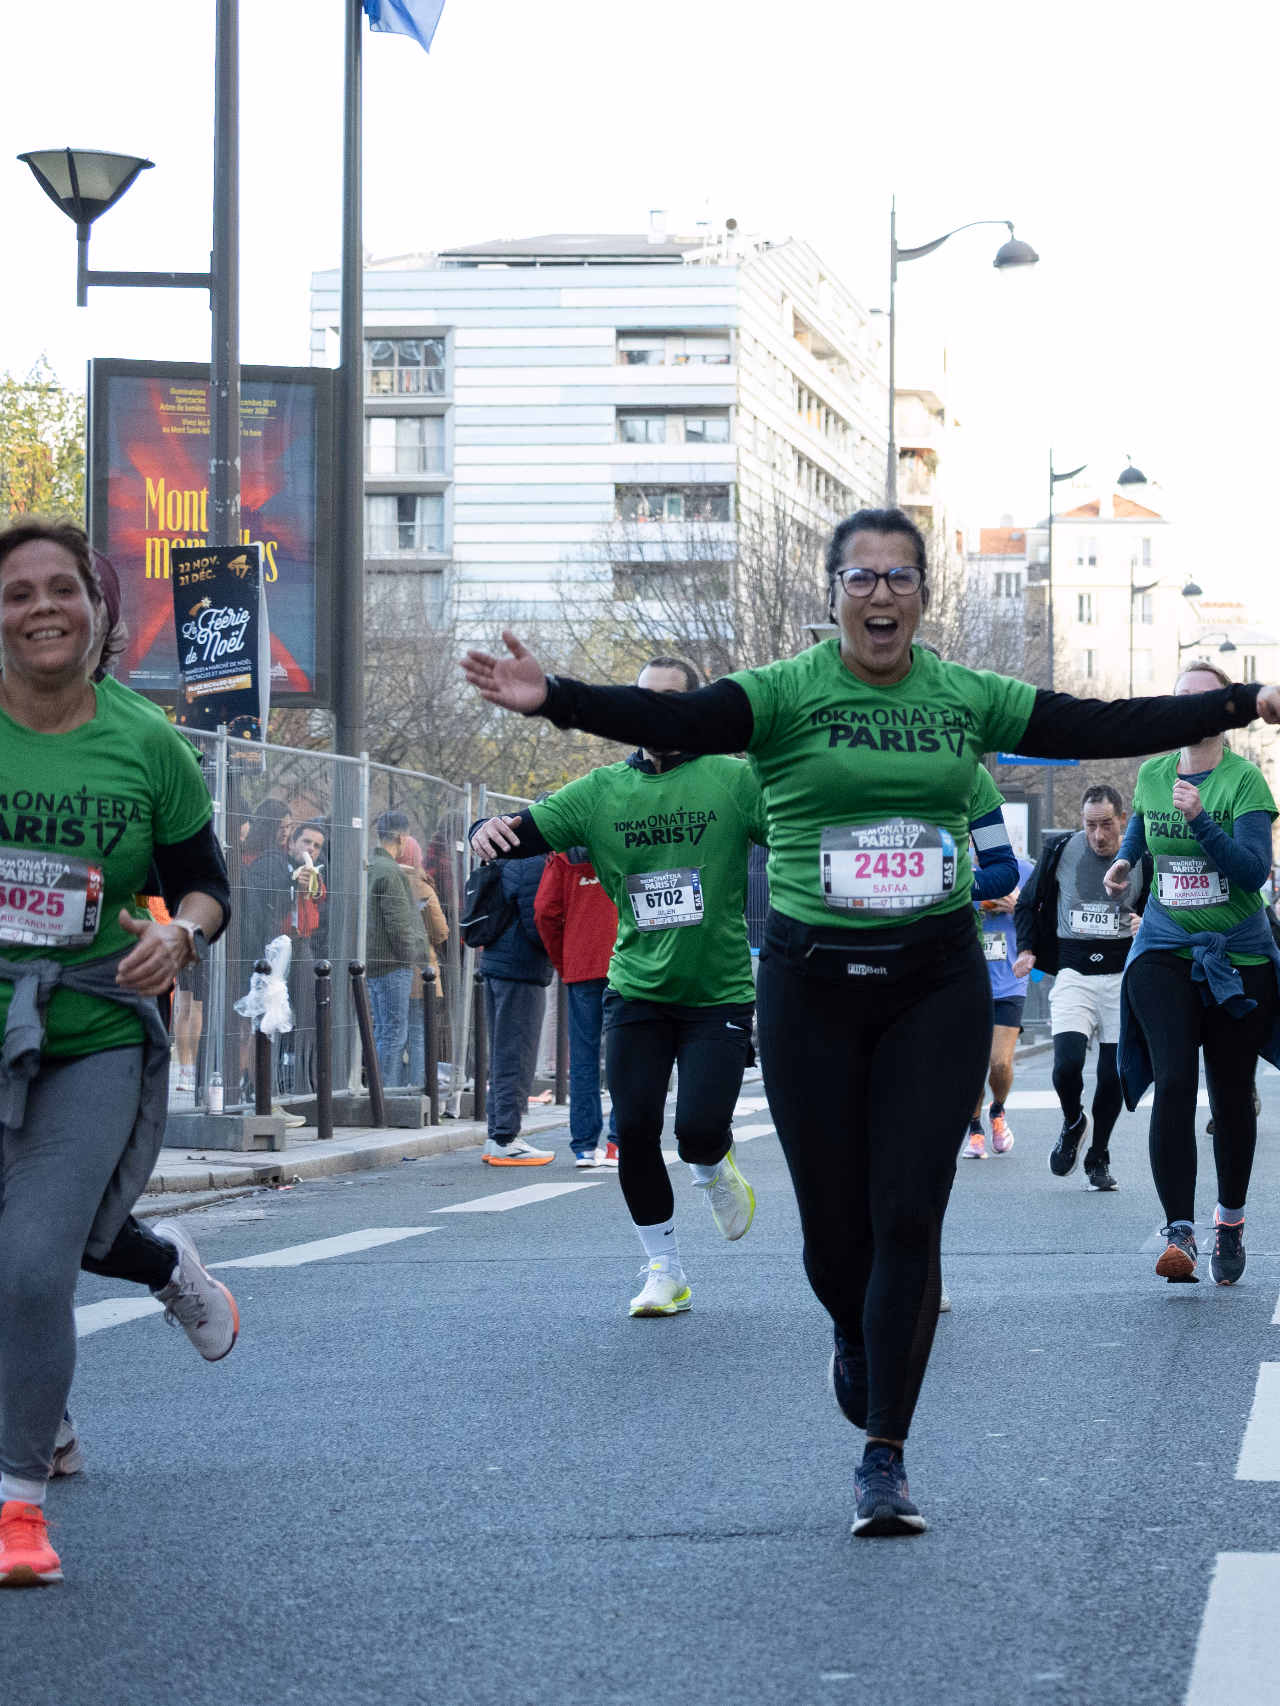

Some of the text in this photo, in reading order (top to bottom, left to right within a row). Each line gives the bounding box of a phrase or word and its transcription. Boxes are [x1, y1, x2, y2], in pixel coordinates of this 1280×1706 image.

[145, 477, 209, 533] Mont
[178, 555, 220, 574] 22 NOV.
[178, 567, 217, 586] 21 DÉC.
[185, 622, 248, 665] de Noël
[854, 851, 925, 879] 2433
[943, 862, 954, 885] SAS
[873, 883, 909, 894] SAFAA
[1172, 875, 1210, 890] 7028
[1219, 878, 1227, 891] SAS
[645, 889, 684, 909] 6702
[694, 893, 702, 907] SAS
[1174, 890, 1210, 898] RAPHAELLE
[85, 905, 97, 928] SAS
[657, 908, 676, 916] JULIEN
[1081, 912, 1109, 925] 6703
[18, 917, 64, 931] CAROLINE
[847, 962, 888, 976] FlipBelt
